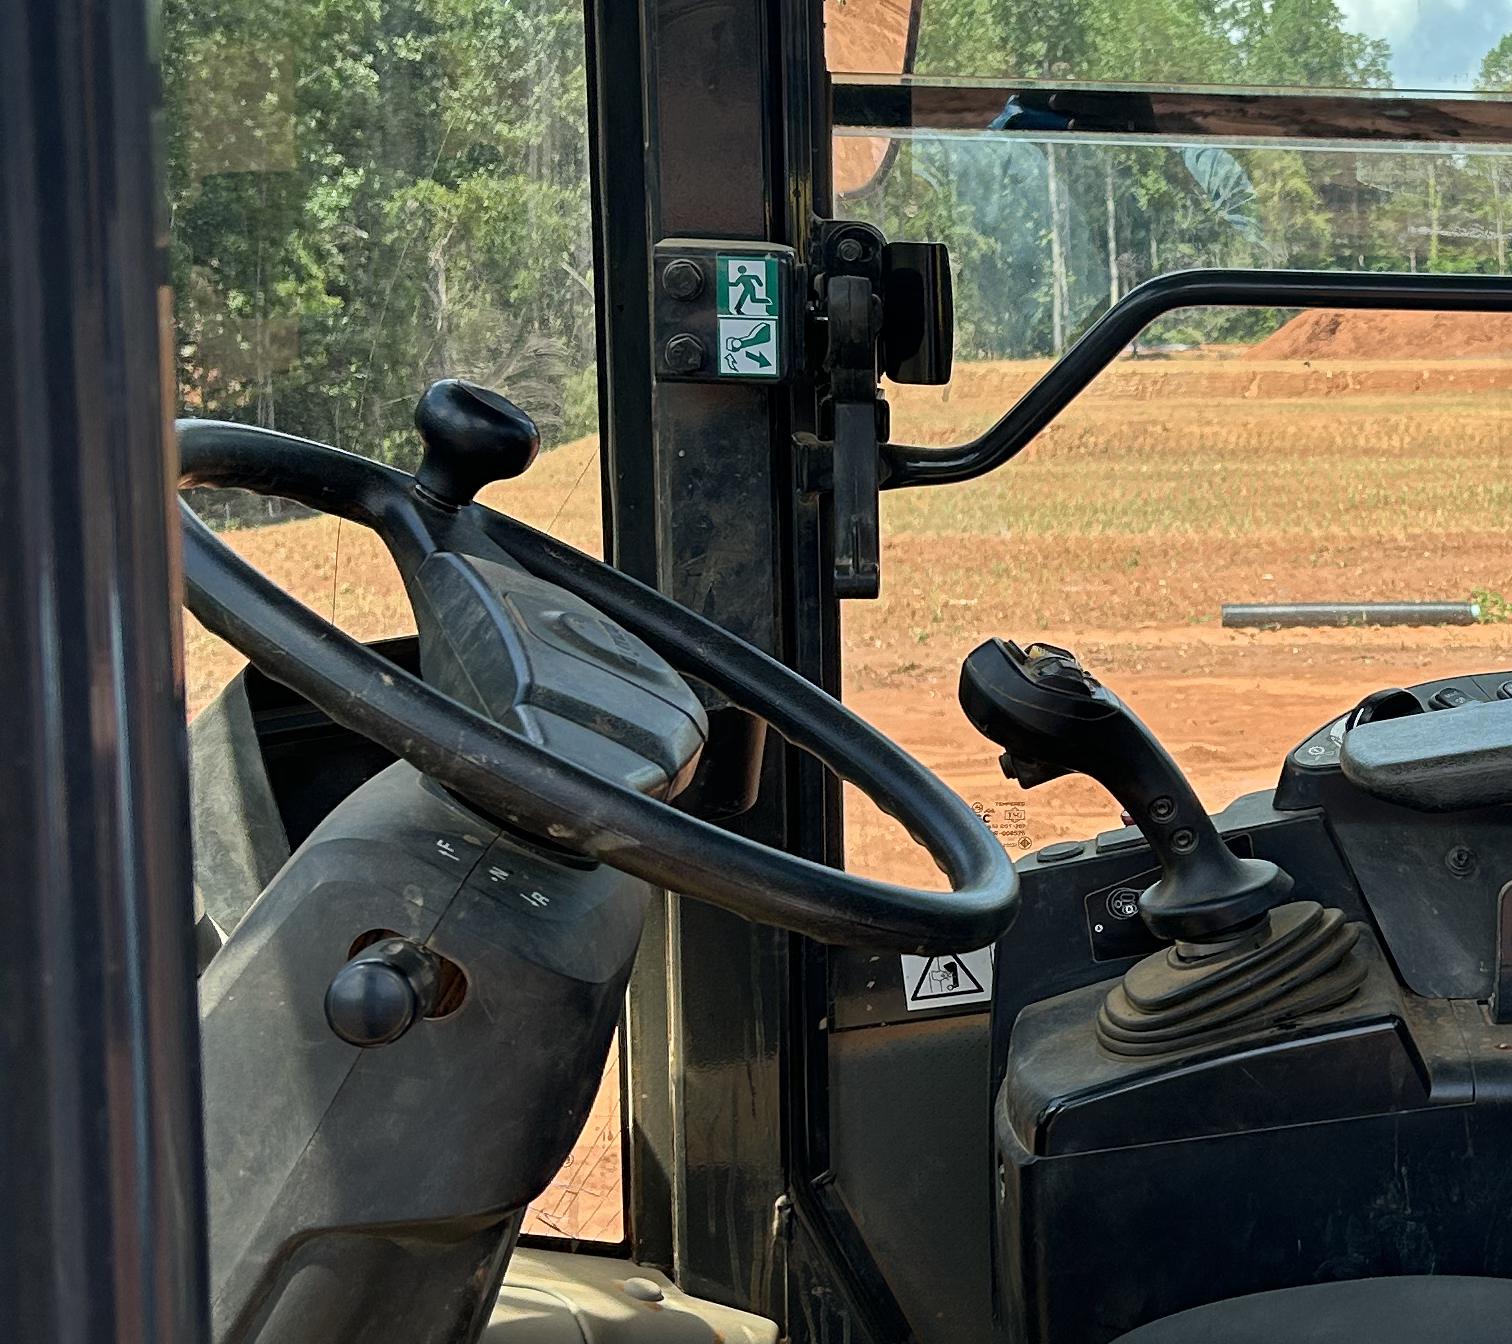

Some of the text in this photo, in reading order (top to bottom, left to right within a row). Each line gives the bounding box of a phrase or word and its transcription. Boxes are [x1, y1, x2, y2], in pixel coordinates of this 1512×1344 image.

[436, 839, 455, 853] F
[488, 866, 510, 881] N
[530, 891, 550, 907] R
